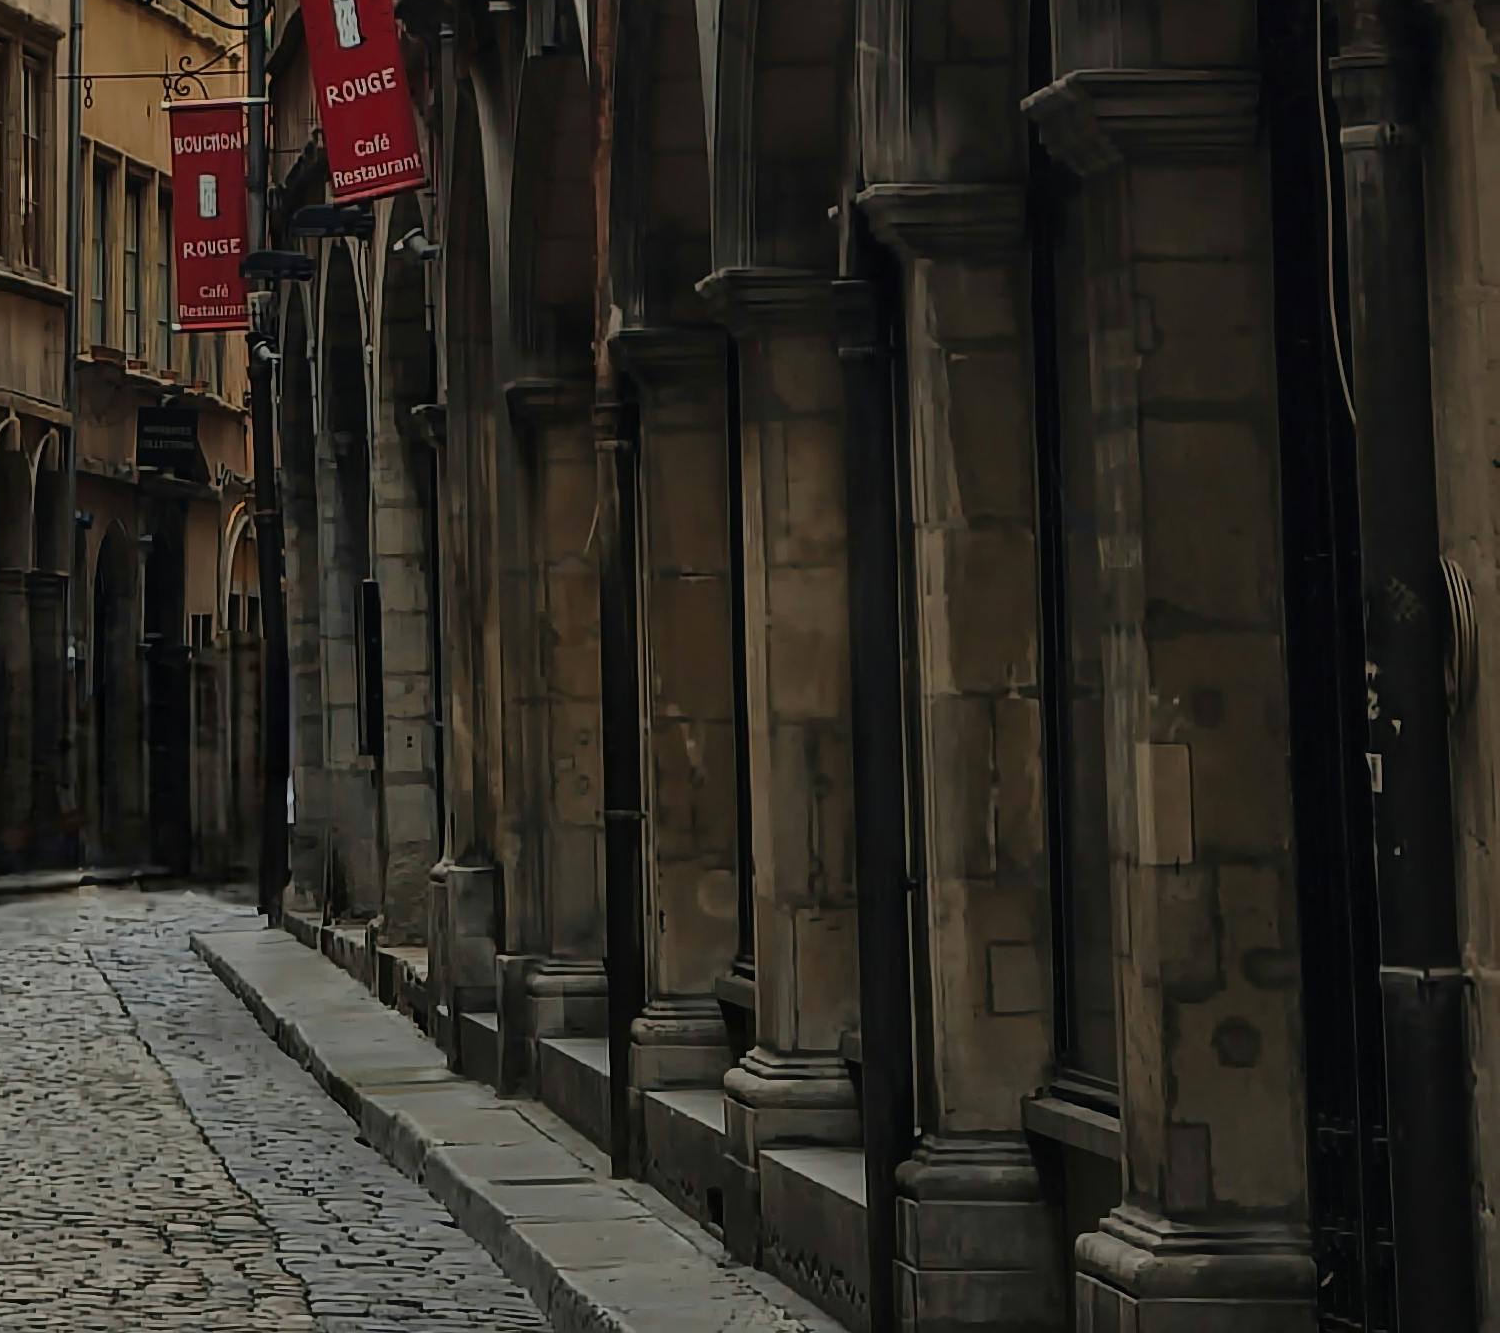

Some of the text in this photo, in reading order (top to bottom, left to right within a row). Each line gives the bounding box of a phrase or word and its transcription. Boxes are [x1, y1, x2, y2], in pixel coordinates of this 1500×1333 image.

[325, 67, 397, 109] ROUGE
[173, 131, 242, 155] BOUCHON
[354, 132, 391, 157] Café
[332, 152, 422, 188] Restaurant
[182, 237, 242, 260] ROUGE
[199, 283, 229, 299] Café
